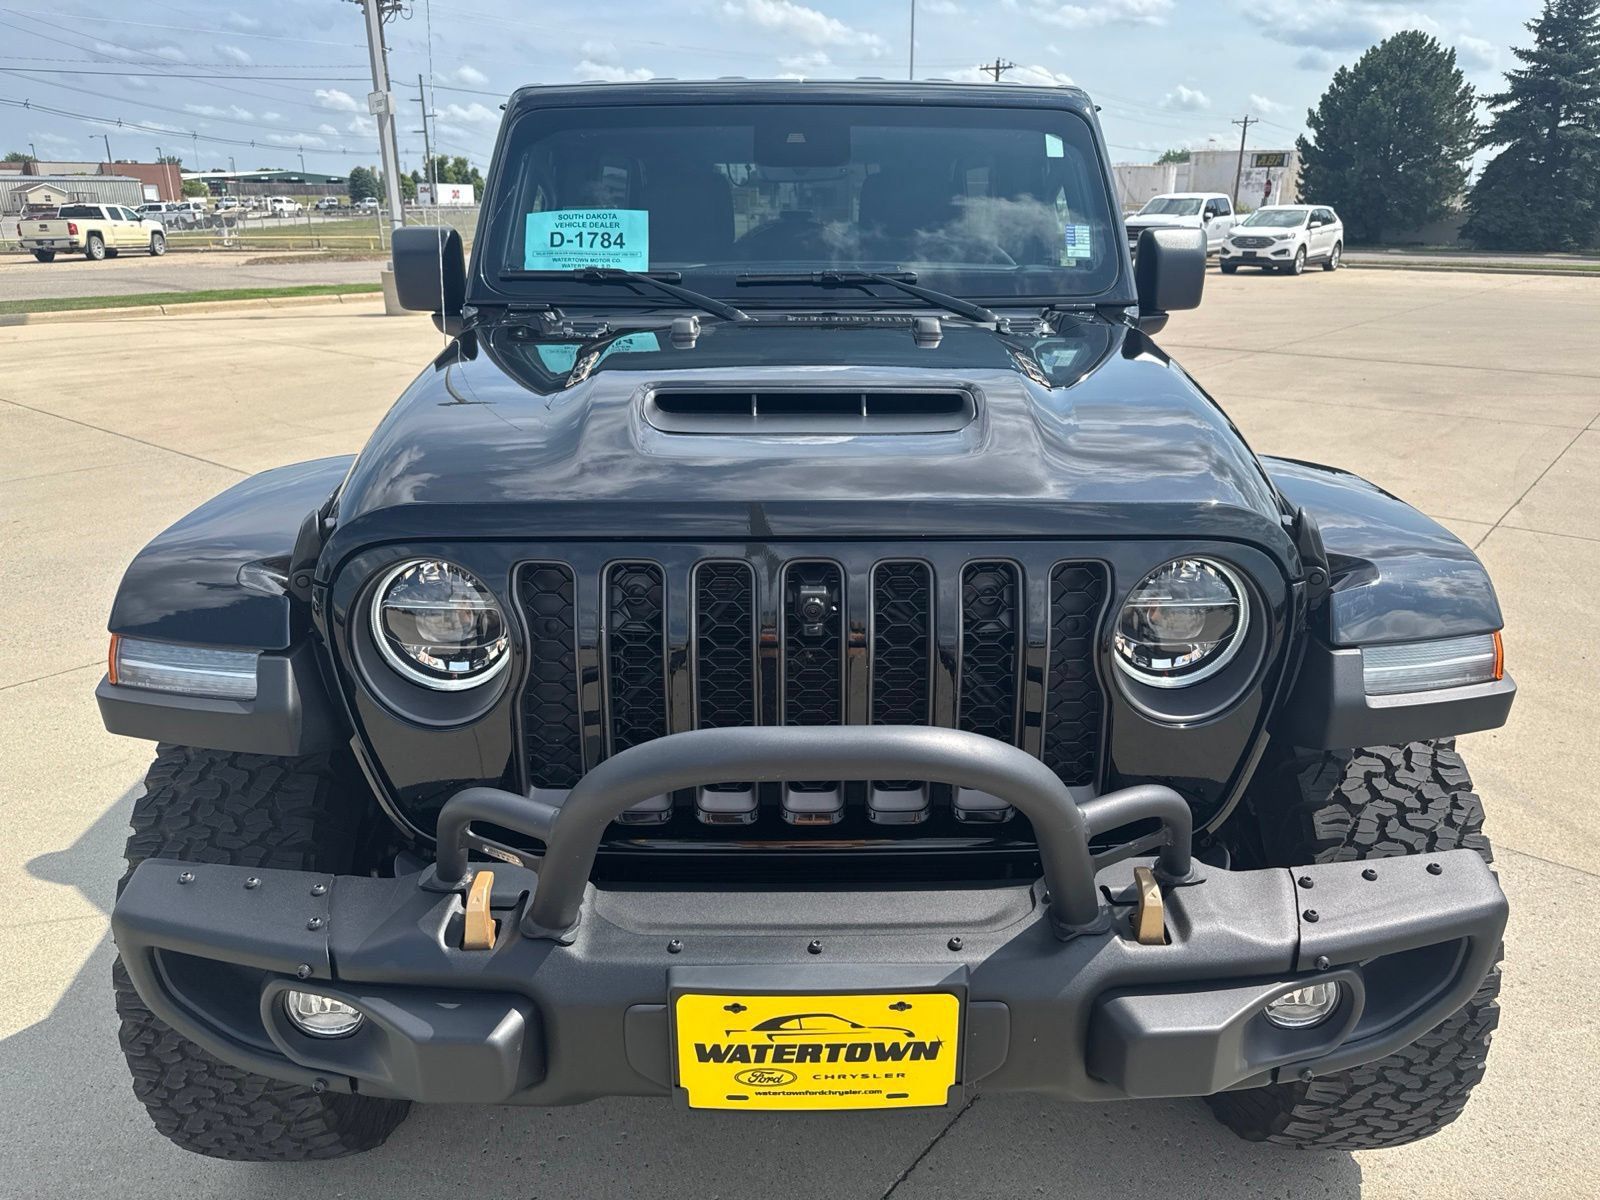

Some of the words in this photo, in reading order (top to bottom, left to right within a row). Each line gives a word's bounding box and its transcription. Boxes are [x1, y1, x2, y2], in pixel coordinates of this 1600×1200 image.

[550, 231, 625, 248] D-1784
[694, 1042, 939, 1063] WATERTOWN
[747, 1070, 784, 1084] Ford
[812, 1072, 906, 1080] CHRYSLER
[754, 1088, 882, 1096] watertownfordchrysler.com
